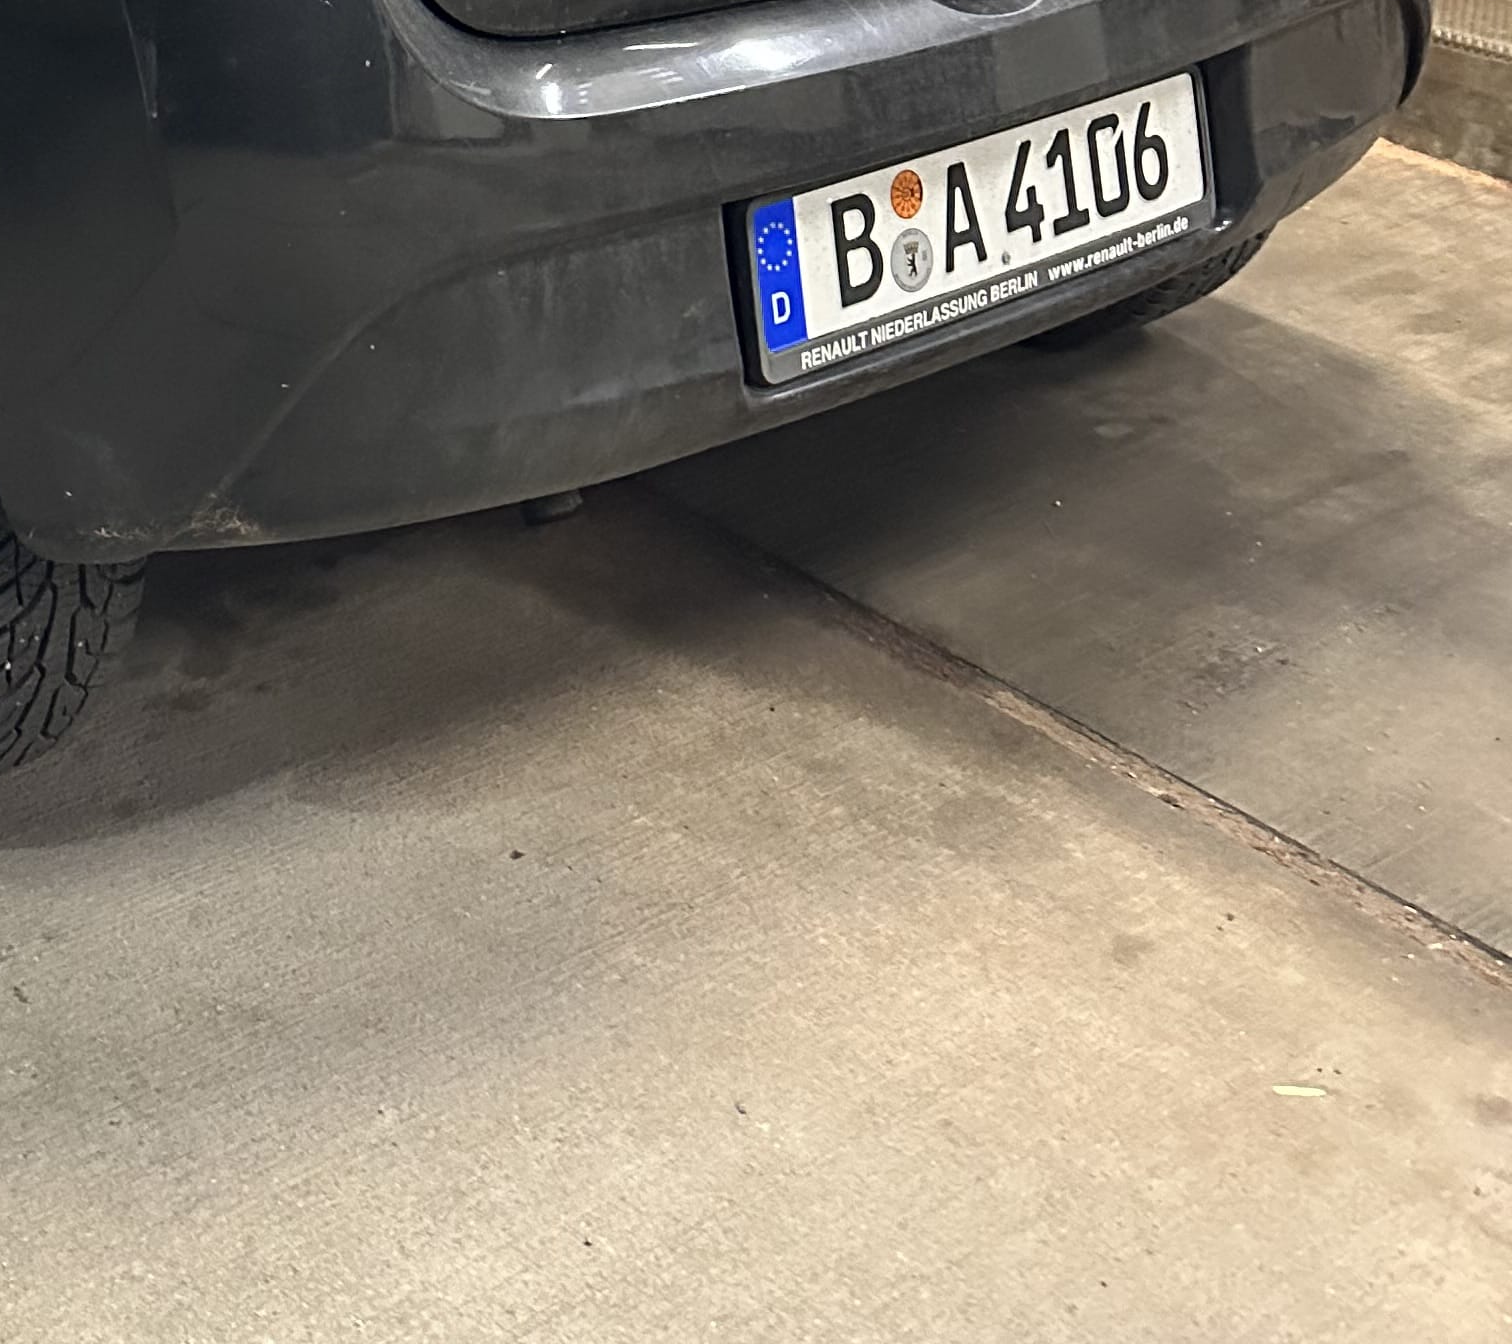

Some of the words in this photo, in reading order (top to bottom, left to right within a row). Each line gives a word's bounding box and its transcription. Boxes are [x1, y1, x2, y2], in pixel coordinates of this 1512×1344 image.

[1005, 102, 1169, 243] 4106
[771, 292, 791, 325] D
[800, 330, 868, 369] RENAULT
[870, 288, 988, 344] NIEDERLASSUNG
[990, 271, 1038, 303] BERLIN
[1047, 216, 1189, 281] www.renault-berlin.de
